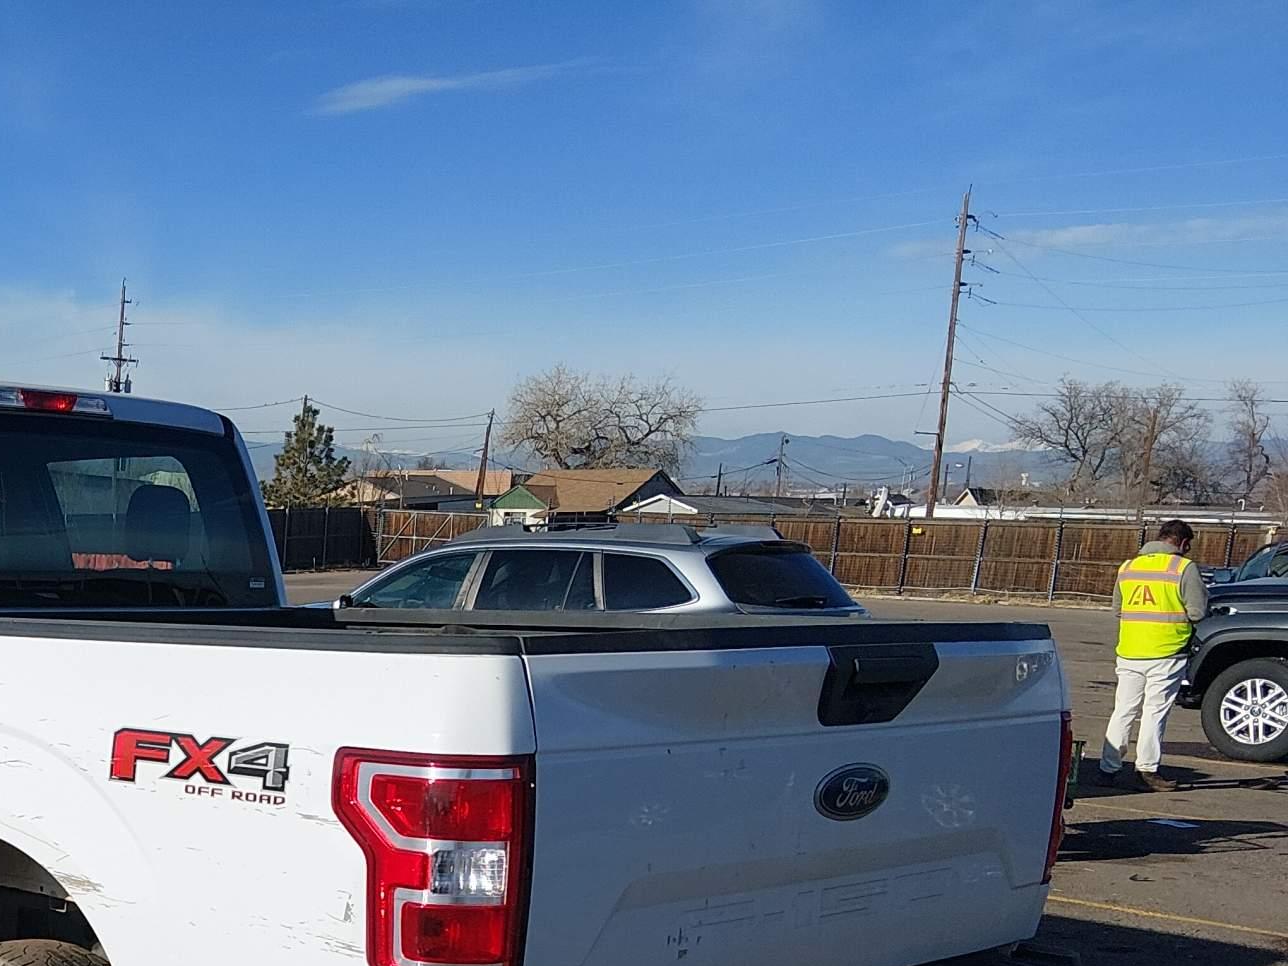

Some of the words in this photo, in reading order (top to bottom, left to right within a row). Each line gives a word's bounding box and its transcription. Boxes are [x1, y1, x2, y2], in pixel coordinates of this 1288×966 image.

[109, 727, 290, 793] FX4
[184, 784, 224, 798] OFF
[231, 790, 286, 805] ROAD
[836, 777, 878, 808] Ford
